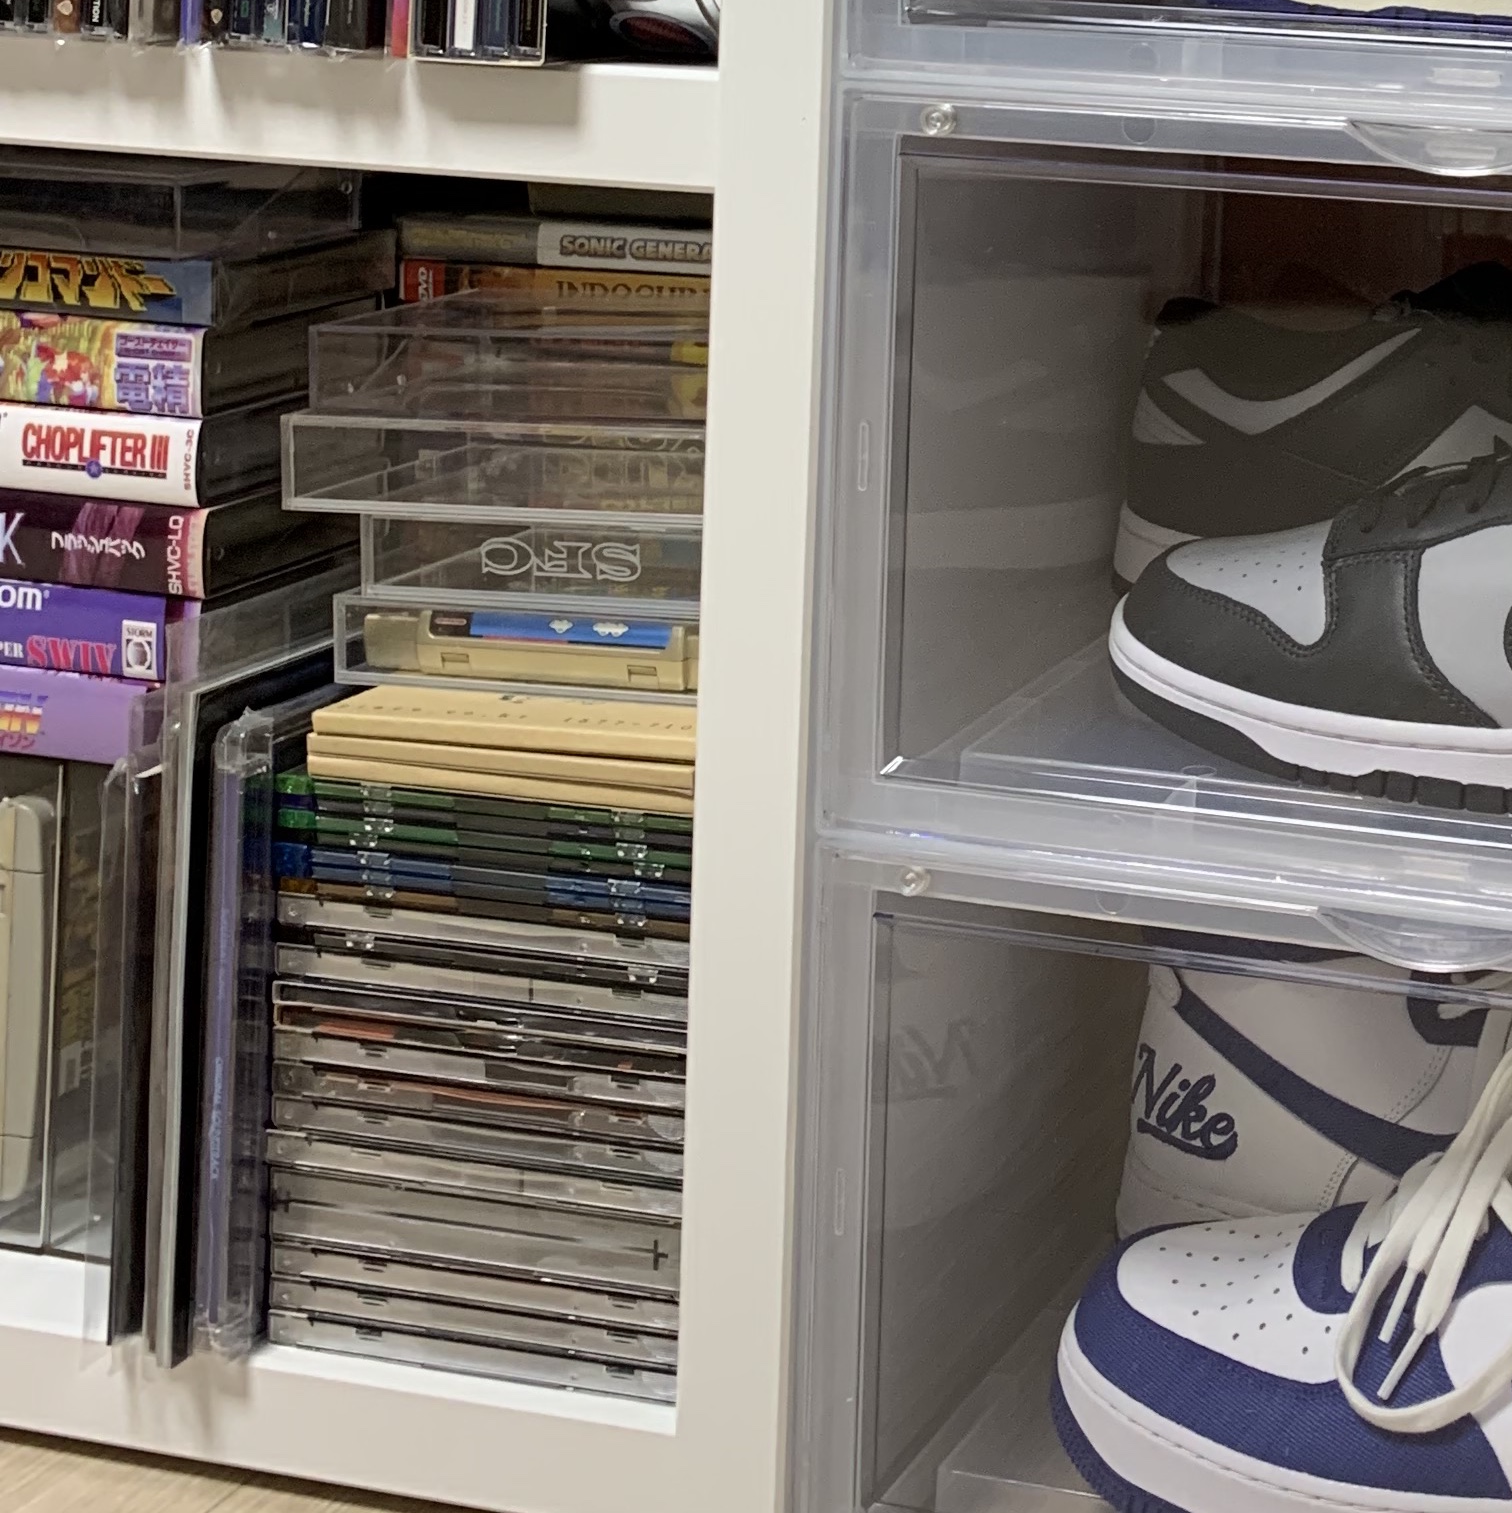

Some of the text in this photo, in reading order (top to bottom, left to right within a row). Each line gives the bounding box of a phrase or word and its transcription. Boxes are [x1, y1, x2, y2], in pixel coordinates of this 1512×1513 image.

[559, 234, 627, 259] SONIC
[22, 422, 170, 471] CHOPLIFTER III
[26, 634, 117, 675] SWIV
[1131, 1043, 1238, 1160] Nike
